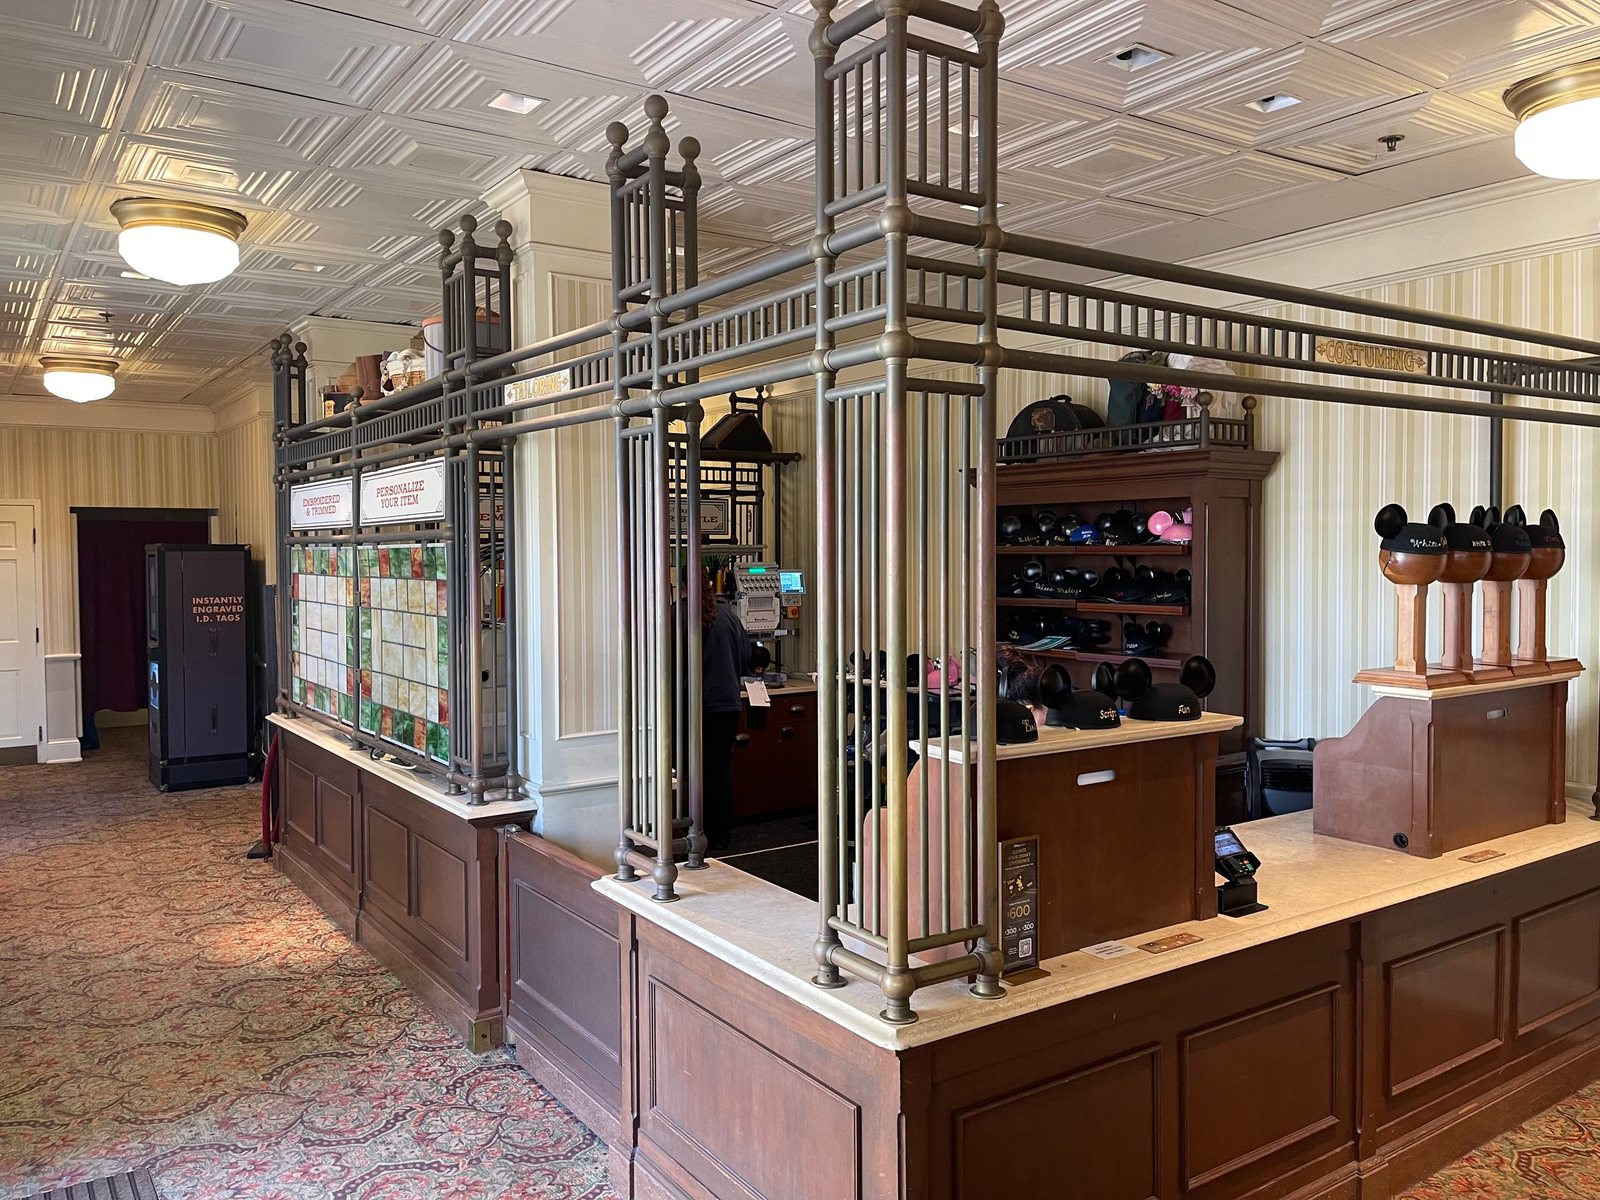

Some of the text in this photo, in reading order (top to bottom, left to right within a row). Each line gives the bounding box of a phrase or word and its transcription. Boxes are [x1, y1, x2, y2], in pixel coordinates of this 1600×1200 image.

[1326, 340, 1415, 372] COSTUMING
[512, 373, 561, 400] TAILORING
[376, 480, 425, 497] PERSONALIZE
[302, 494, 341, 507] EMBROIDERED
[380, 494, 419, 509] YOUR ITEM
[311, 505, 337, 516] TRIMMED
[192, 596, 243, 604] INSTANTLY
[192, 605, 244, 613] ENGRAVED
[216, 614, 240, 622] TAGS
[1178, 704, 1191, 714] Fun
